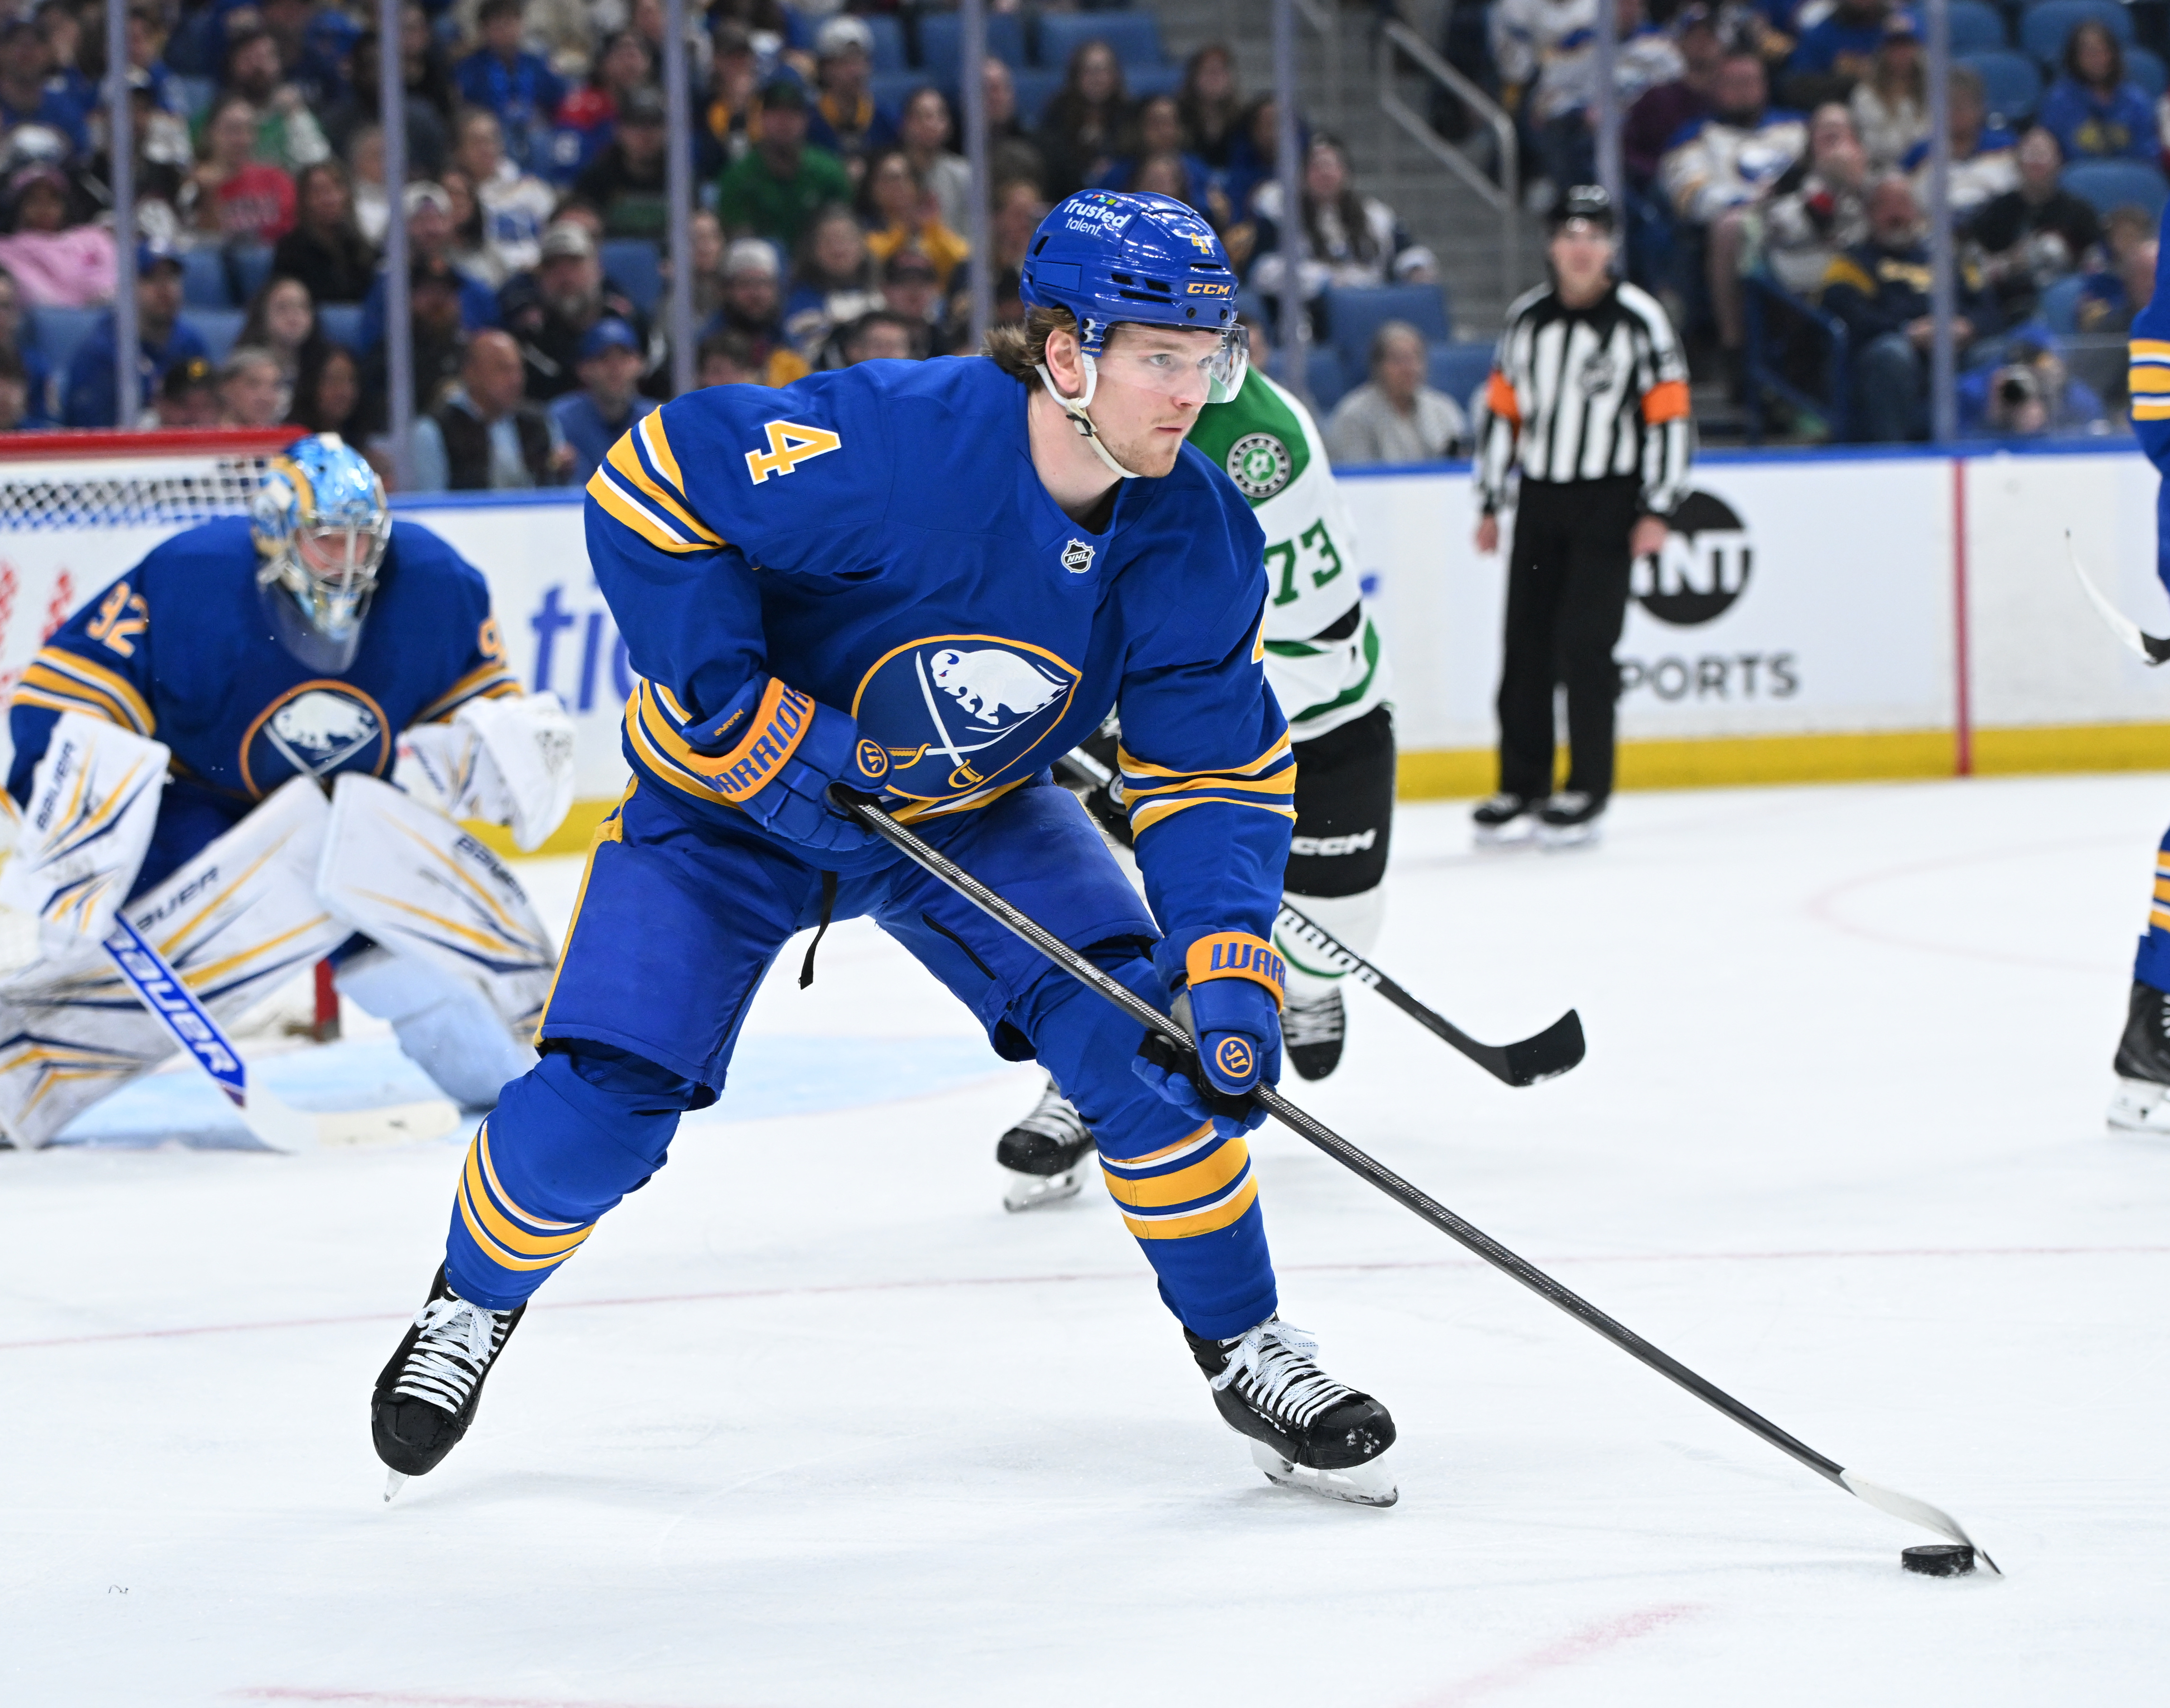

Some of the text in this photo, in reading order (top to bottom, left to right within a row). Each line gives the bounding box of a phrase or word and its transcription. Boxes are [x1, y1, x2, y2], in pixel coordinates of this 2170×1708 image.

[1063, 199, 1132, 229] Trusted
[1065, 216, 1102, 236] talent
[1190, 233, 1209, 254] 4
[1187, 283, 1231, 295] CCM
[745, 420, 842, 485] 4
[1067, 552, 1088, 563] NHL
[1264, 518, 1342, 607] 73
[86, 581, 149, 658] 92
[1290, 827, 1378, 857] CCM
